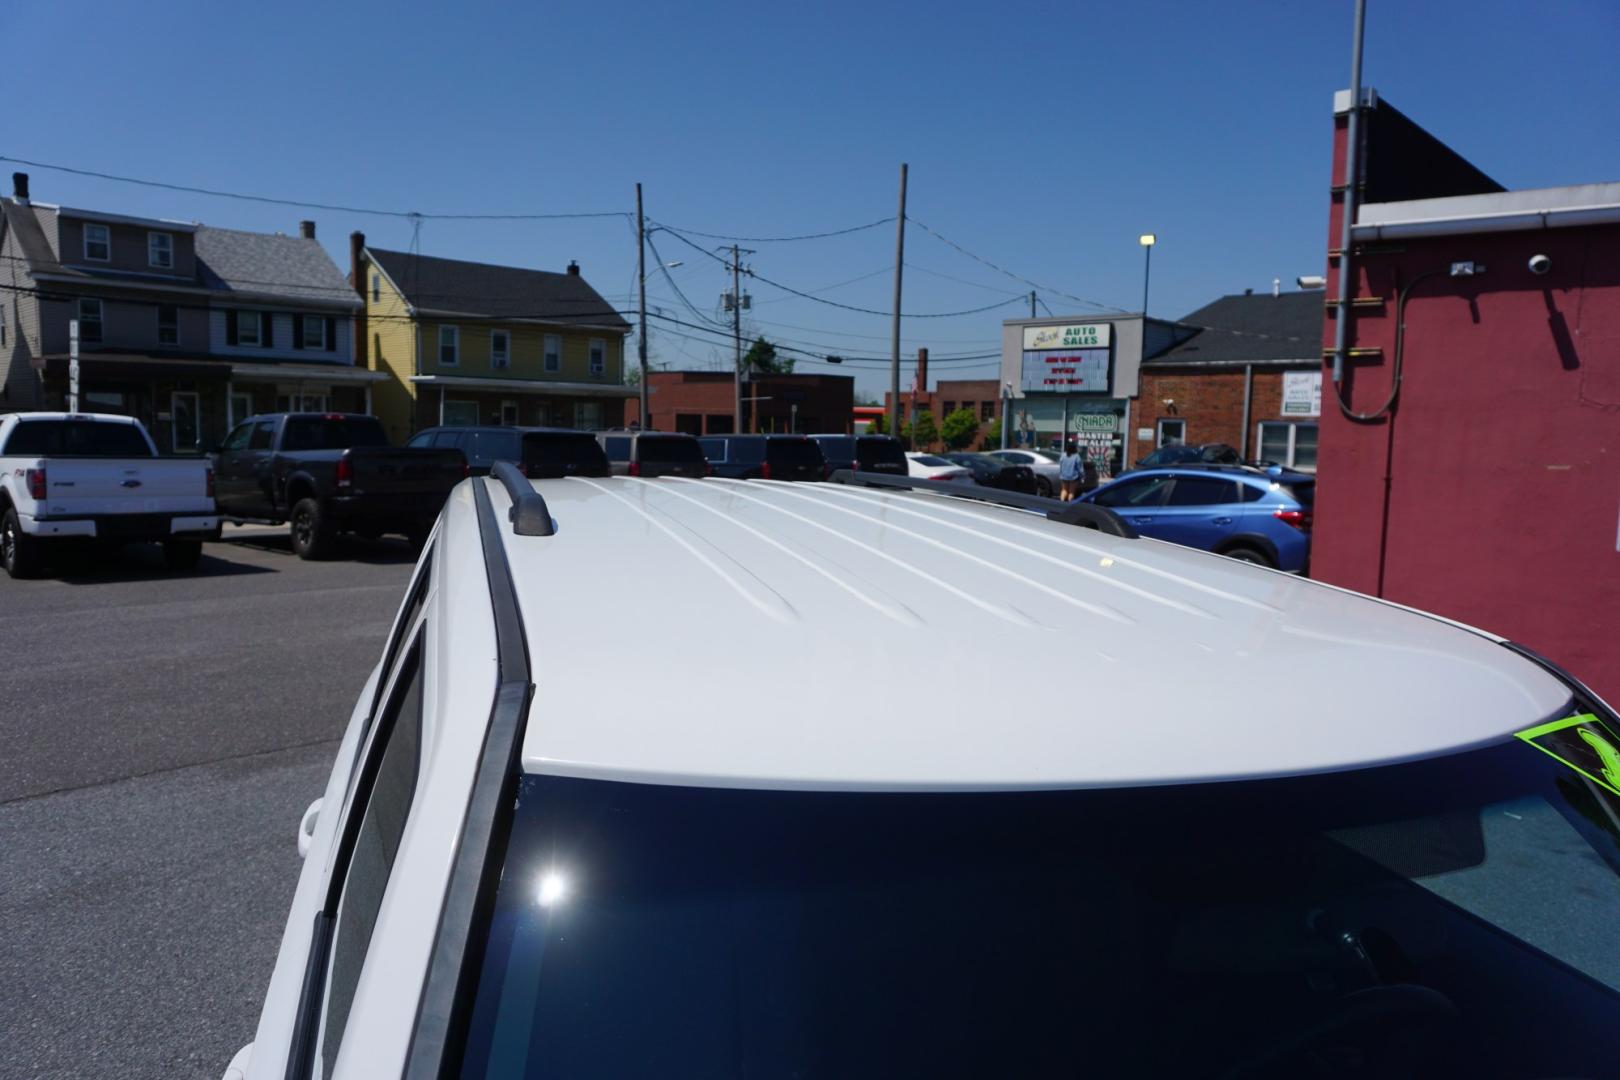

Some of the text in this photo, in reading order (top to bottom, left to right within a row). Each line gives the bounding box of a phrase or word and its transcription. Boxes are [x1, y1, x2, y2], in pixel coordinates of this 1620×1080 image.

[1065, 326, 1096, 336] AUTO
[1063, 336, 1098, 345] SALES
[1077, 416, 1113, 429] NIADA
[1077, 432, 1113, 440] MASTER
